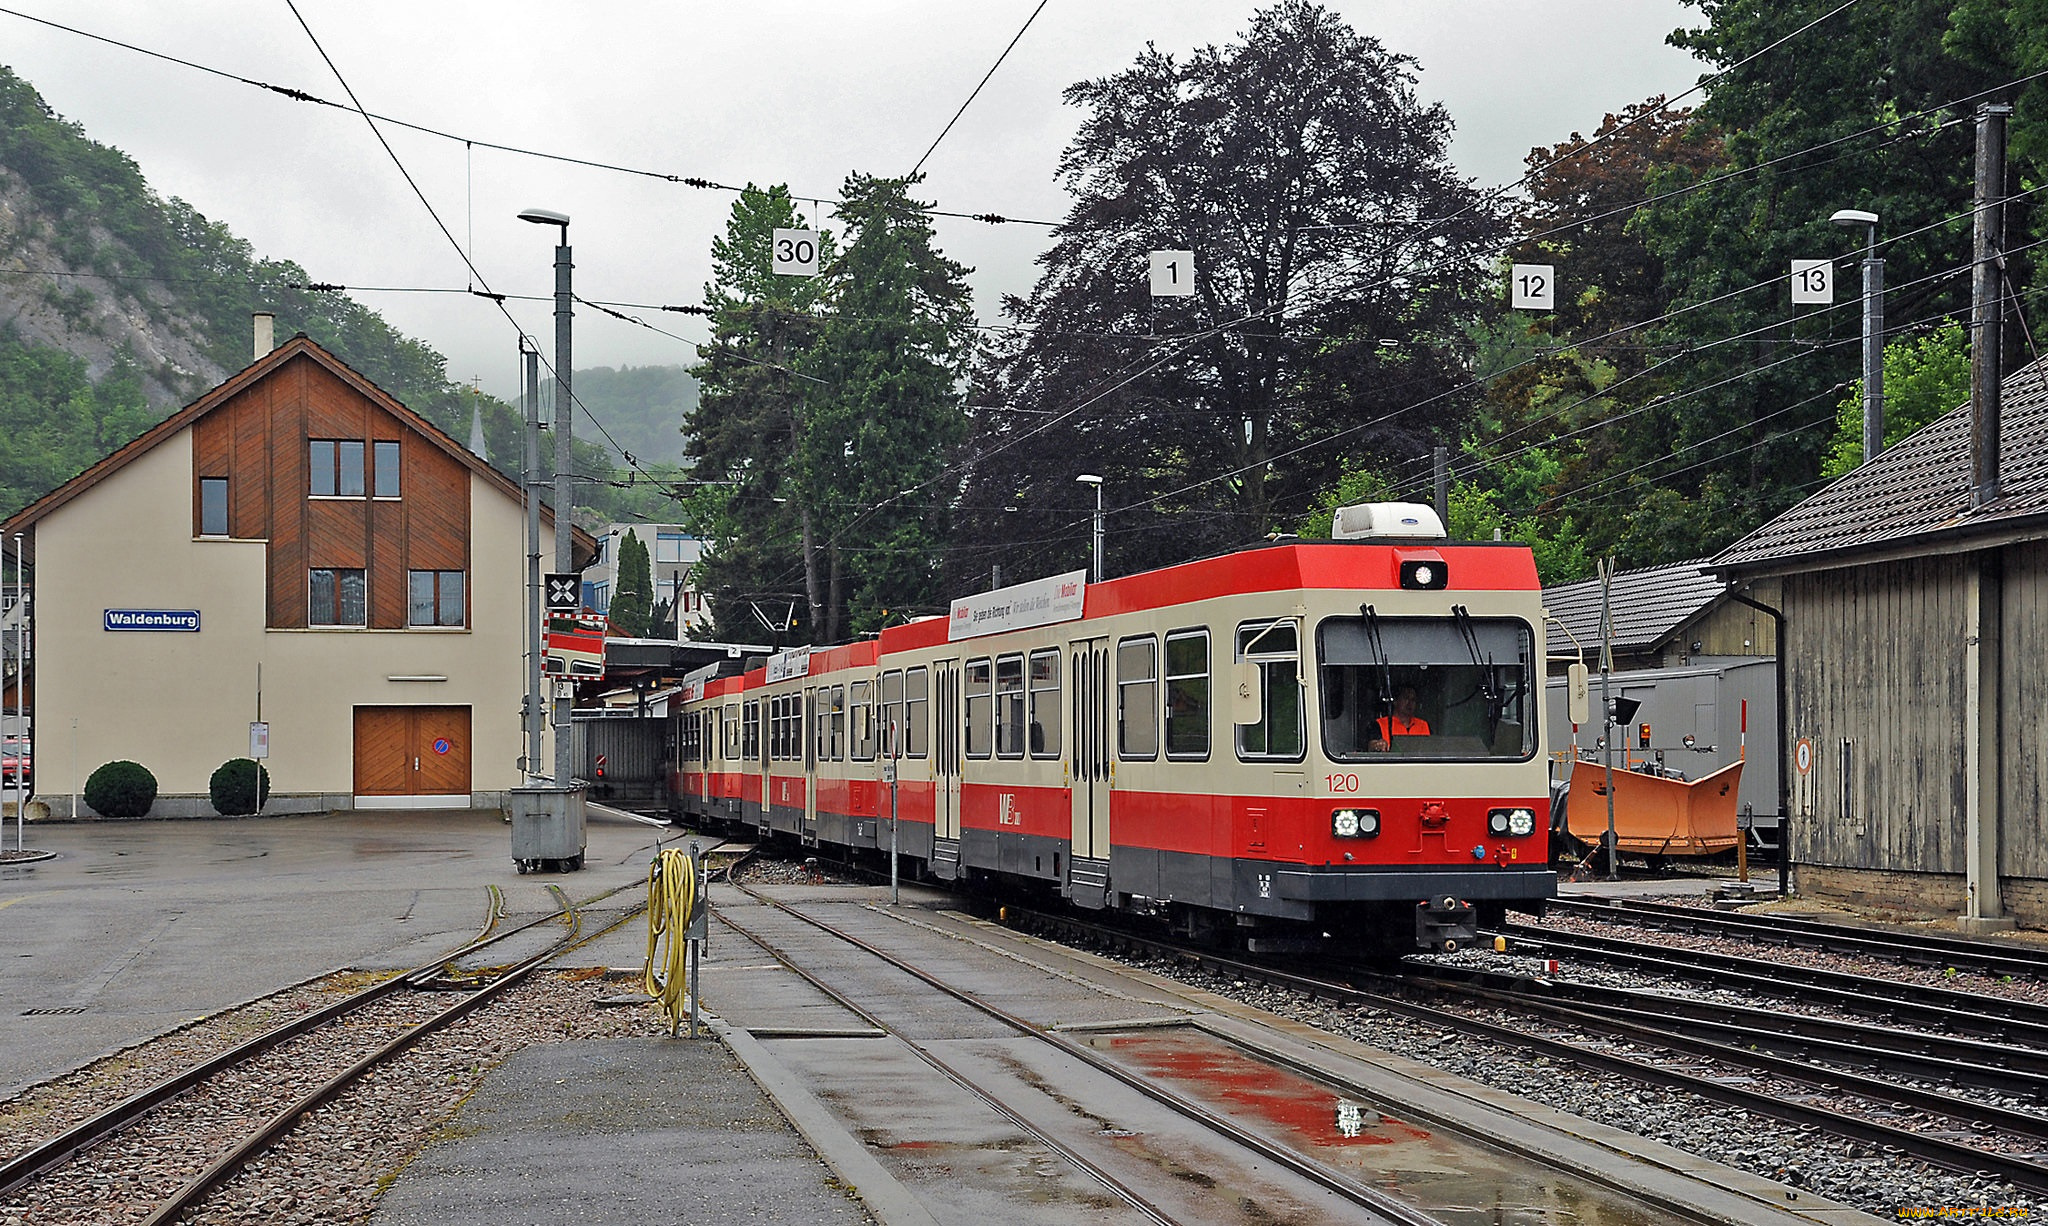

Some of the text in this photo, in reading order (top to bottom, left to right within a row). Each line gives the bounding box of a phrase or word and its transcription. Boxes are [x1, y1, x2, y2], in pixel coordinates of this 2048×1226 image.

[776, 239, 814, 264] 30
[1166, 261, 1177, 284] 1
[1798, 269, 1826, 292] 13
[1518, 274, 1545, 298] 12
[109, 613, 197, 627] Waldenburg
[730, 646, 738, 655] 2
[1325, 773, 1359, 792] 120
